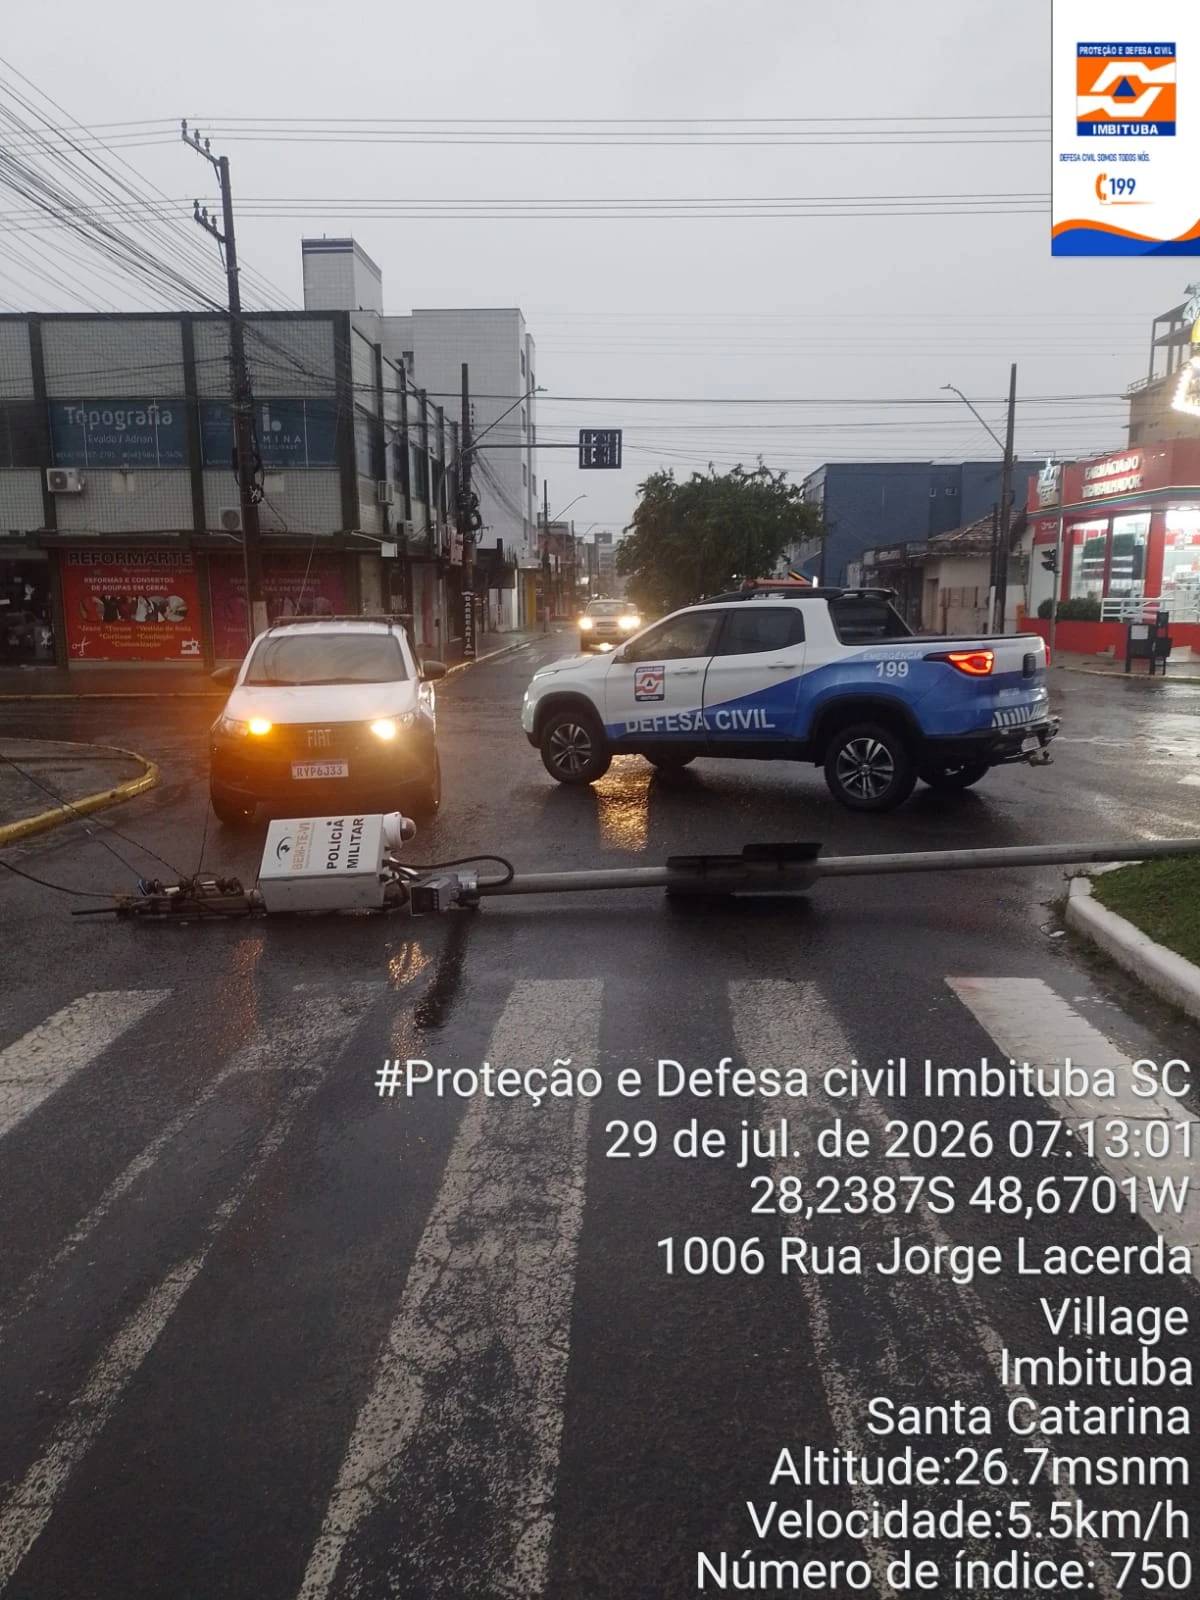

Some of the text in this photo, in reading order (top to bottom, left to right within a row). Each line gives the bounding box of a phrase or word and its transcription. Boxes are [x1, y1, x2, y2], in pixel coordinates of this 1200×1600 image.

[63, 405, 173, 430] Topografia
[68, 551, 193, 566] REFORMARTE
[876, 661, 909, 678] 199
[625, 708, 776, 733] DEFESA CIVIL
[307, 729, 332, 747] FIAT
[347, 818, 364, 869] MILITAR
